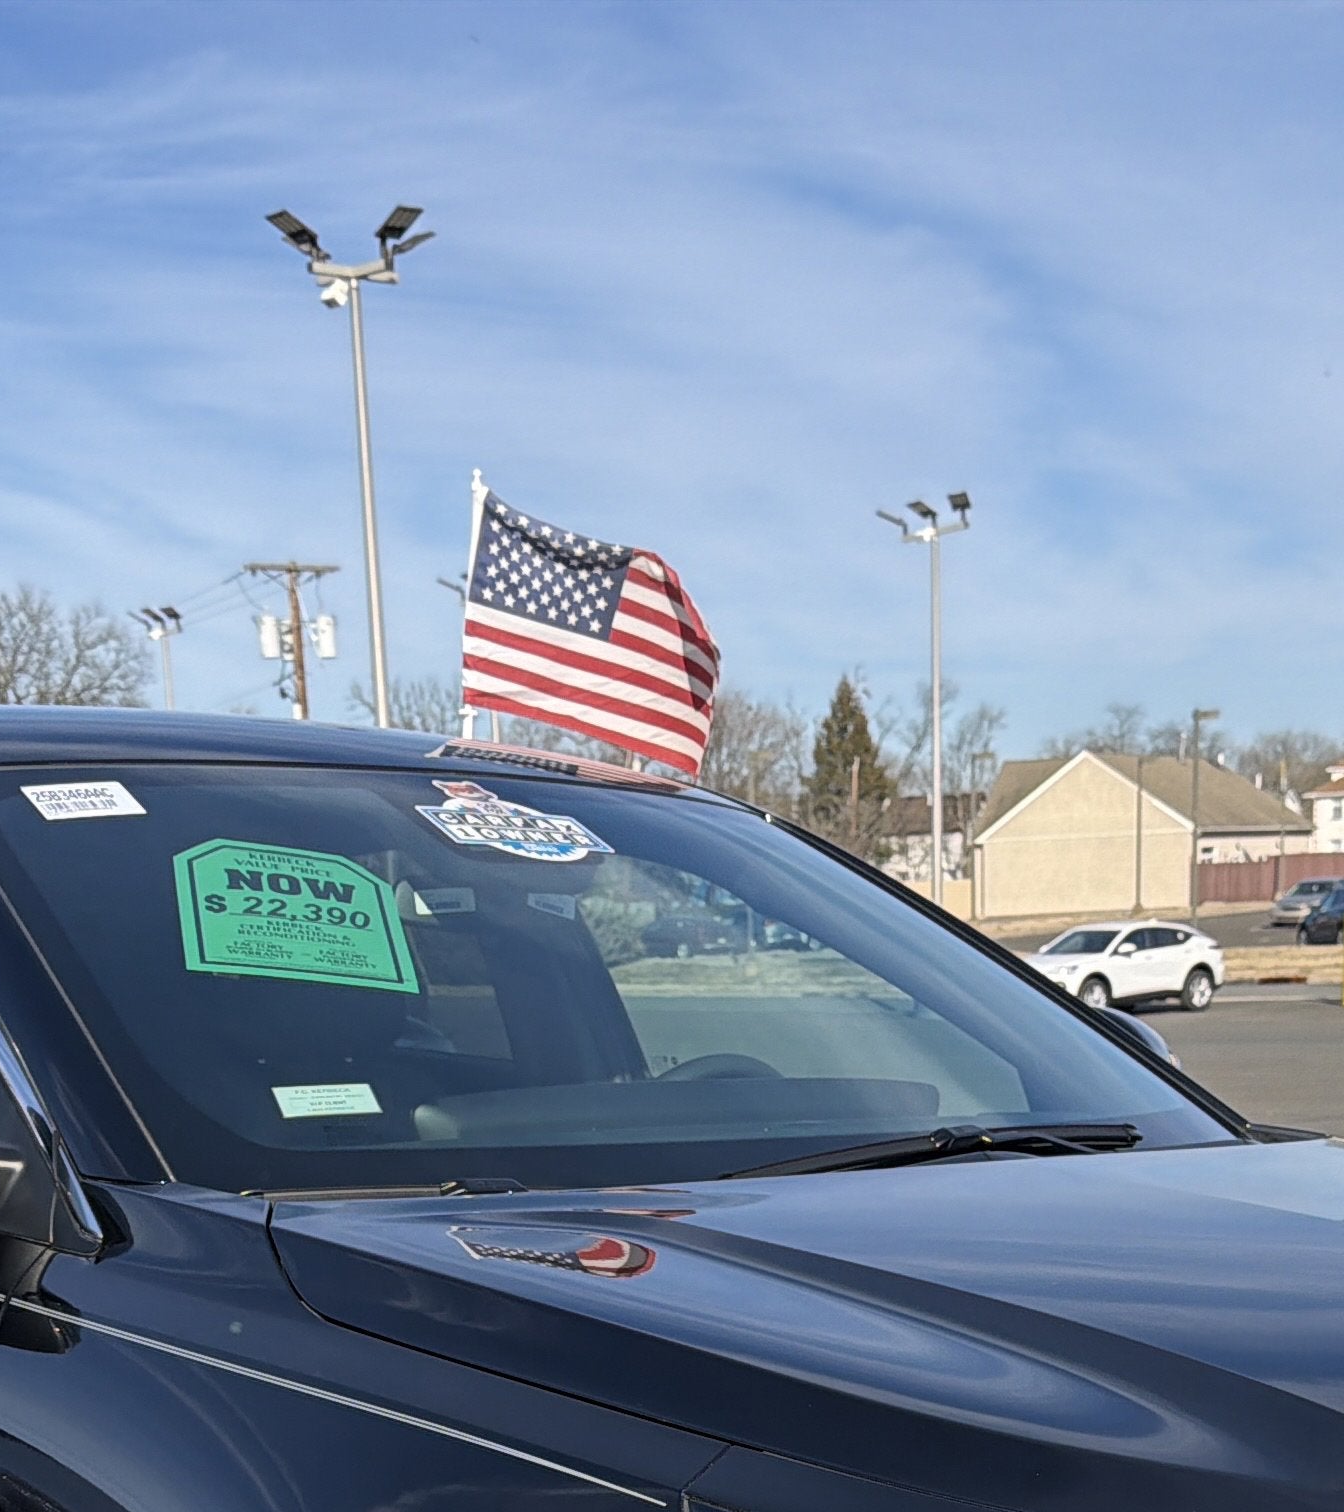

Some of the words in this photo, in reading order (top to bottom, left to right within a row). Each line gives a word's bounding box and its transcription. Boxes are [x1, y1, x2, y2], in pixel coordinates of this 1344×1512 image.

[438, 813, 577, 834] CARFAX
[479, 828, 595, 847] OWNER
[233, 858, 280, 871] VALUE
[290, 866, 333, 878] PRICE
[248, 851, 316, 868] KERBECK
[224, 868, 356, 905] NOW
[204, 894, 227, 914] $
[243, 896, 370, 930] 22,390
